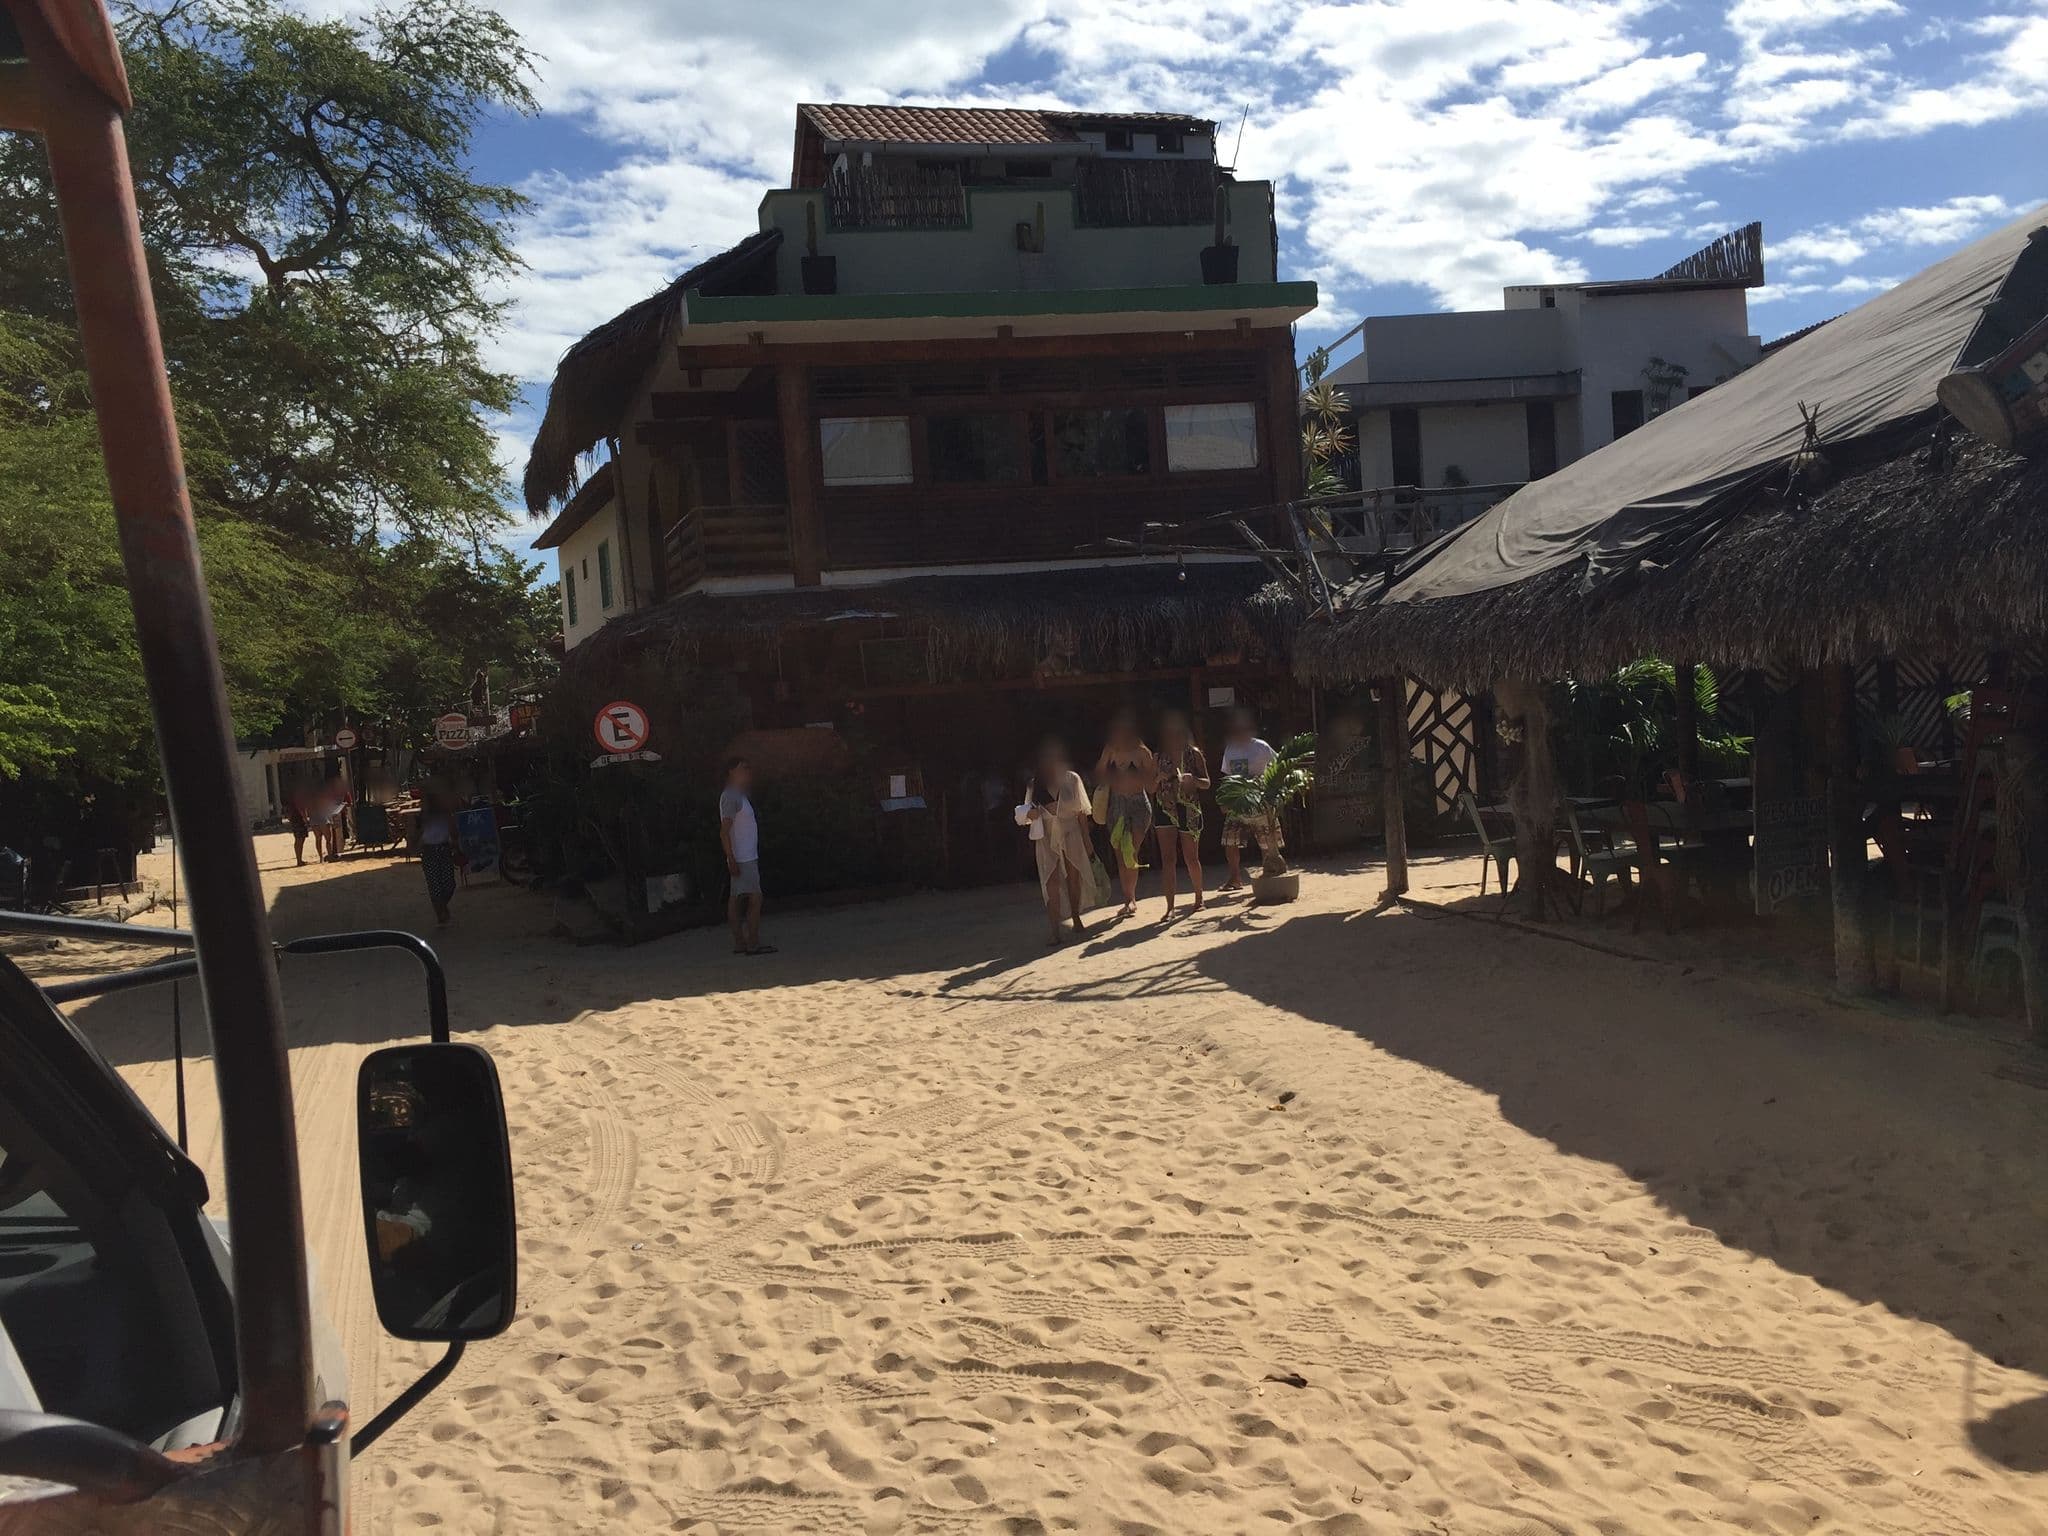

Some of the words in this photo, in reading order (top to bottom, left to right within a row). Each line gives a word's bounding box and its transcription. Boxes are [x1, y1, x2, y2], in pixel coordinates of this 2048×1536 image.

[438, 728, 471, 741] PIZZA
[612, 712, 634, 741] E
[1768, 866, 1823, 902] OPEN
